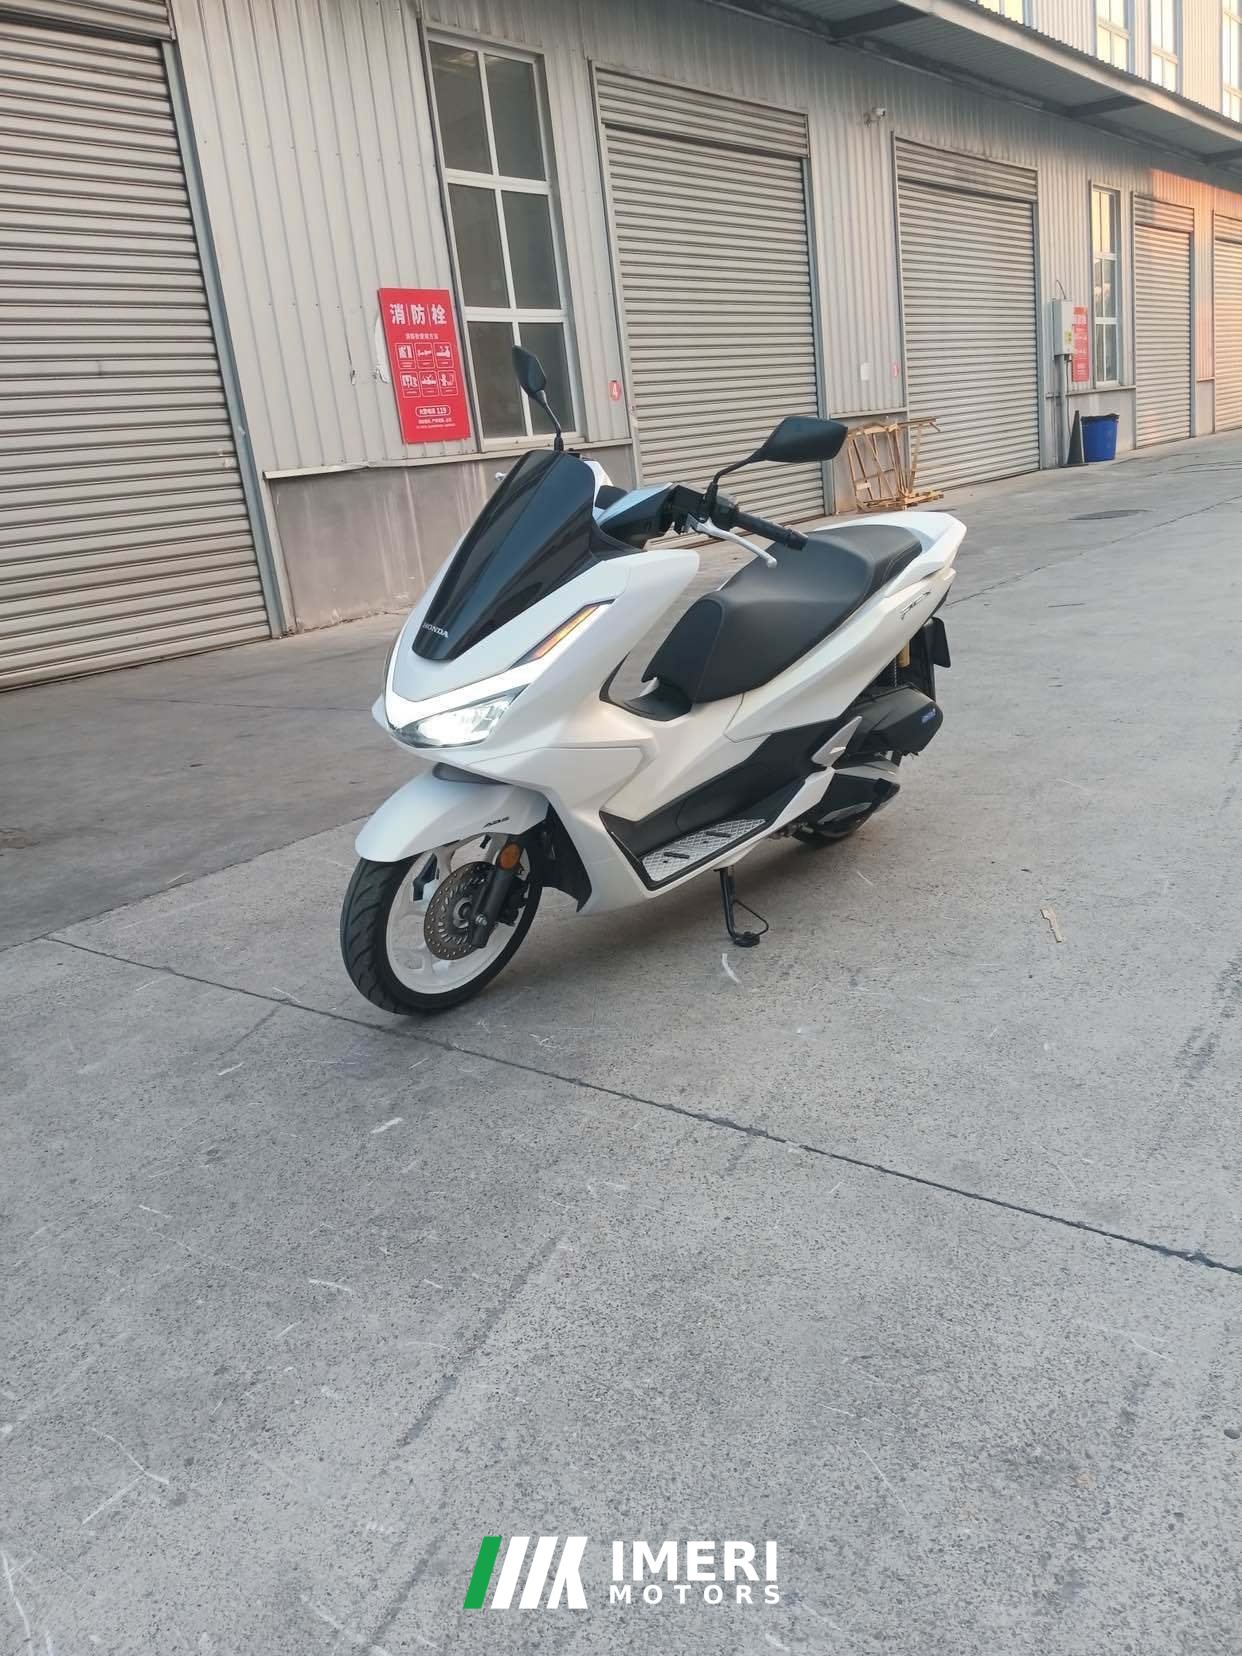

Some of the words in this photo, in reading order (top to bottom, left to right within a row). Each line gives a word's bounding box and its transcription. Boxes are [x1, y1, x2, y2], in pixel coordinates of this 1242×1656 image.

[389, 303, 448, 325] 消防栓
[422, 622, 449, 638] HONDA
